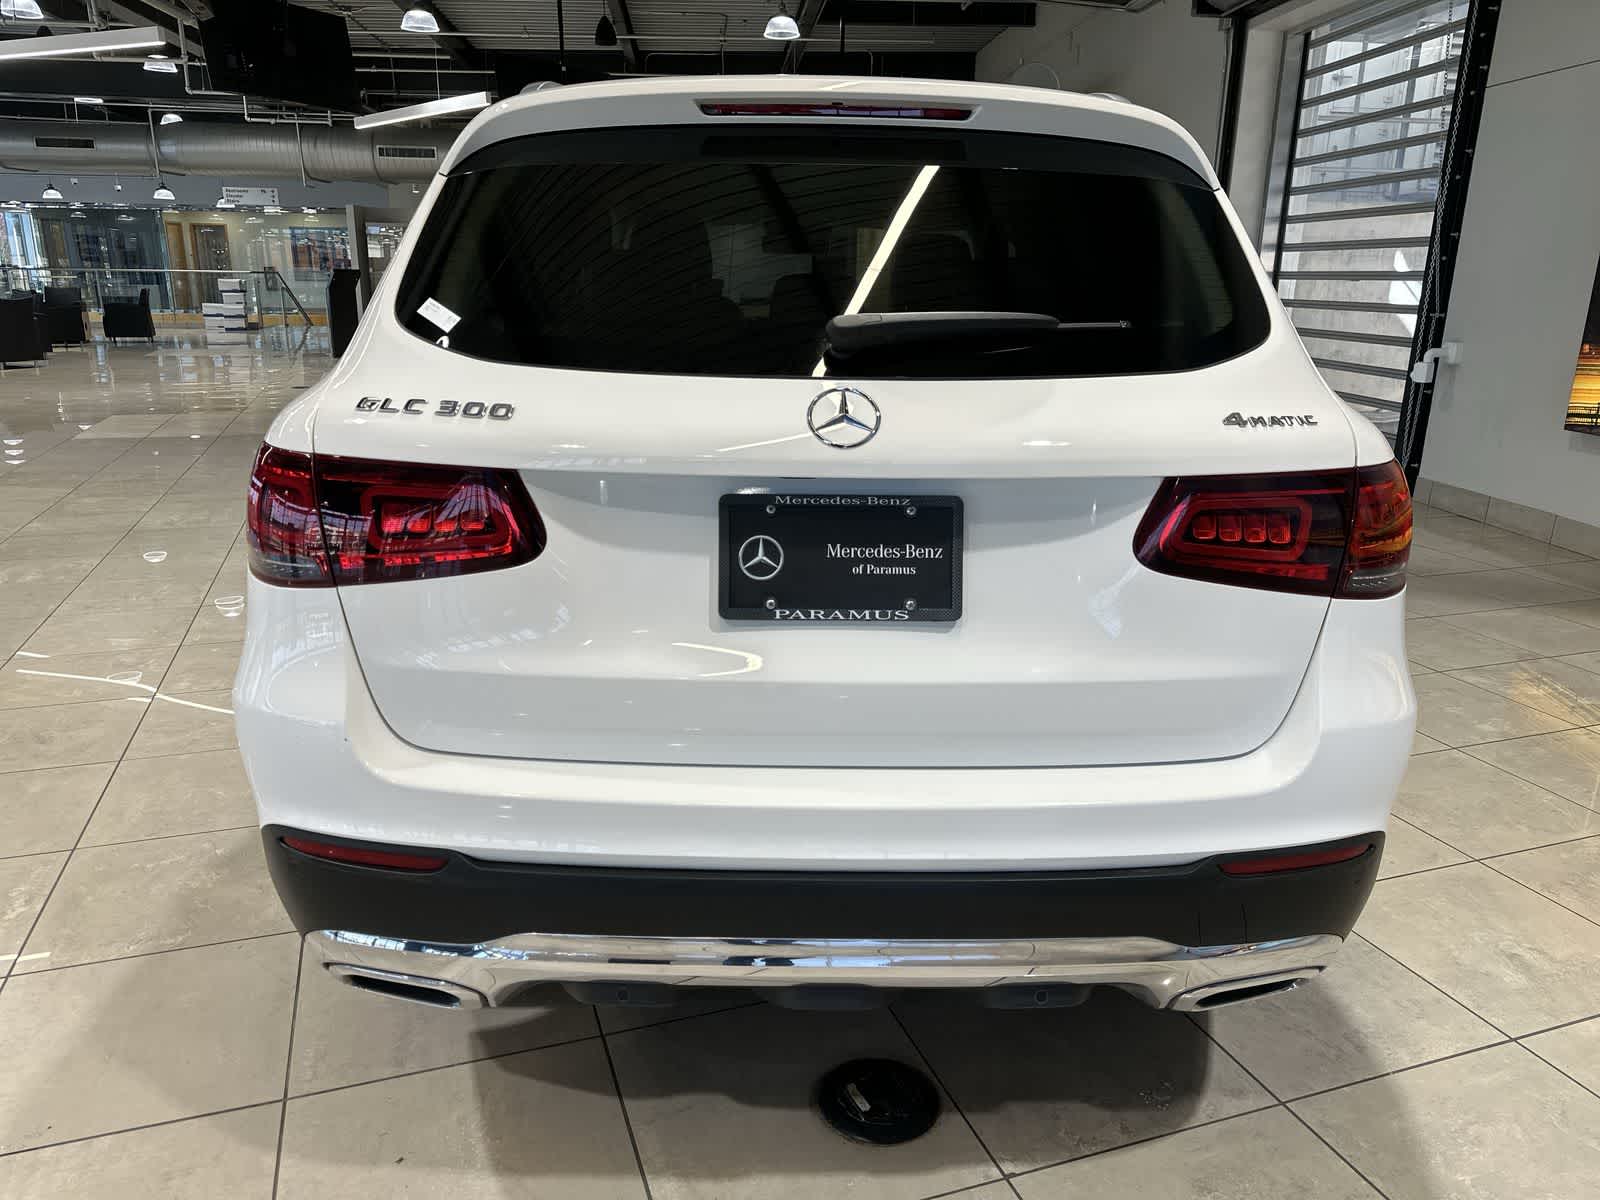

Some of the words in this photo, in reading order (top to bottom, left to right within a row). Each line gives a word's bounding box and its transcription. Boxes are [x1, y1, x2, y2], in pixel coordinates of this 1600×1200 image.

[355, 397, 429, 415] GLC
[434, 400, 515, 420] 300
[1222, 411, 1318, 428] 4MATIC
[775, 495, 912, 506] Mercedes-Benz
[826, 543, 943, 559] Mercedes-Benz
[852, 564, 864, 575] of
[867, 564, 916, 576] Paramus
[775, 609, 910, 620] PARAMUS
